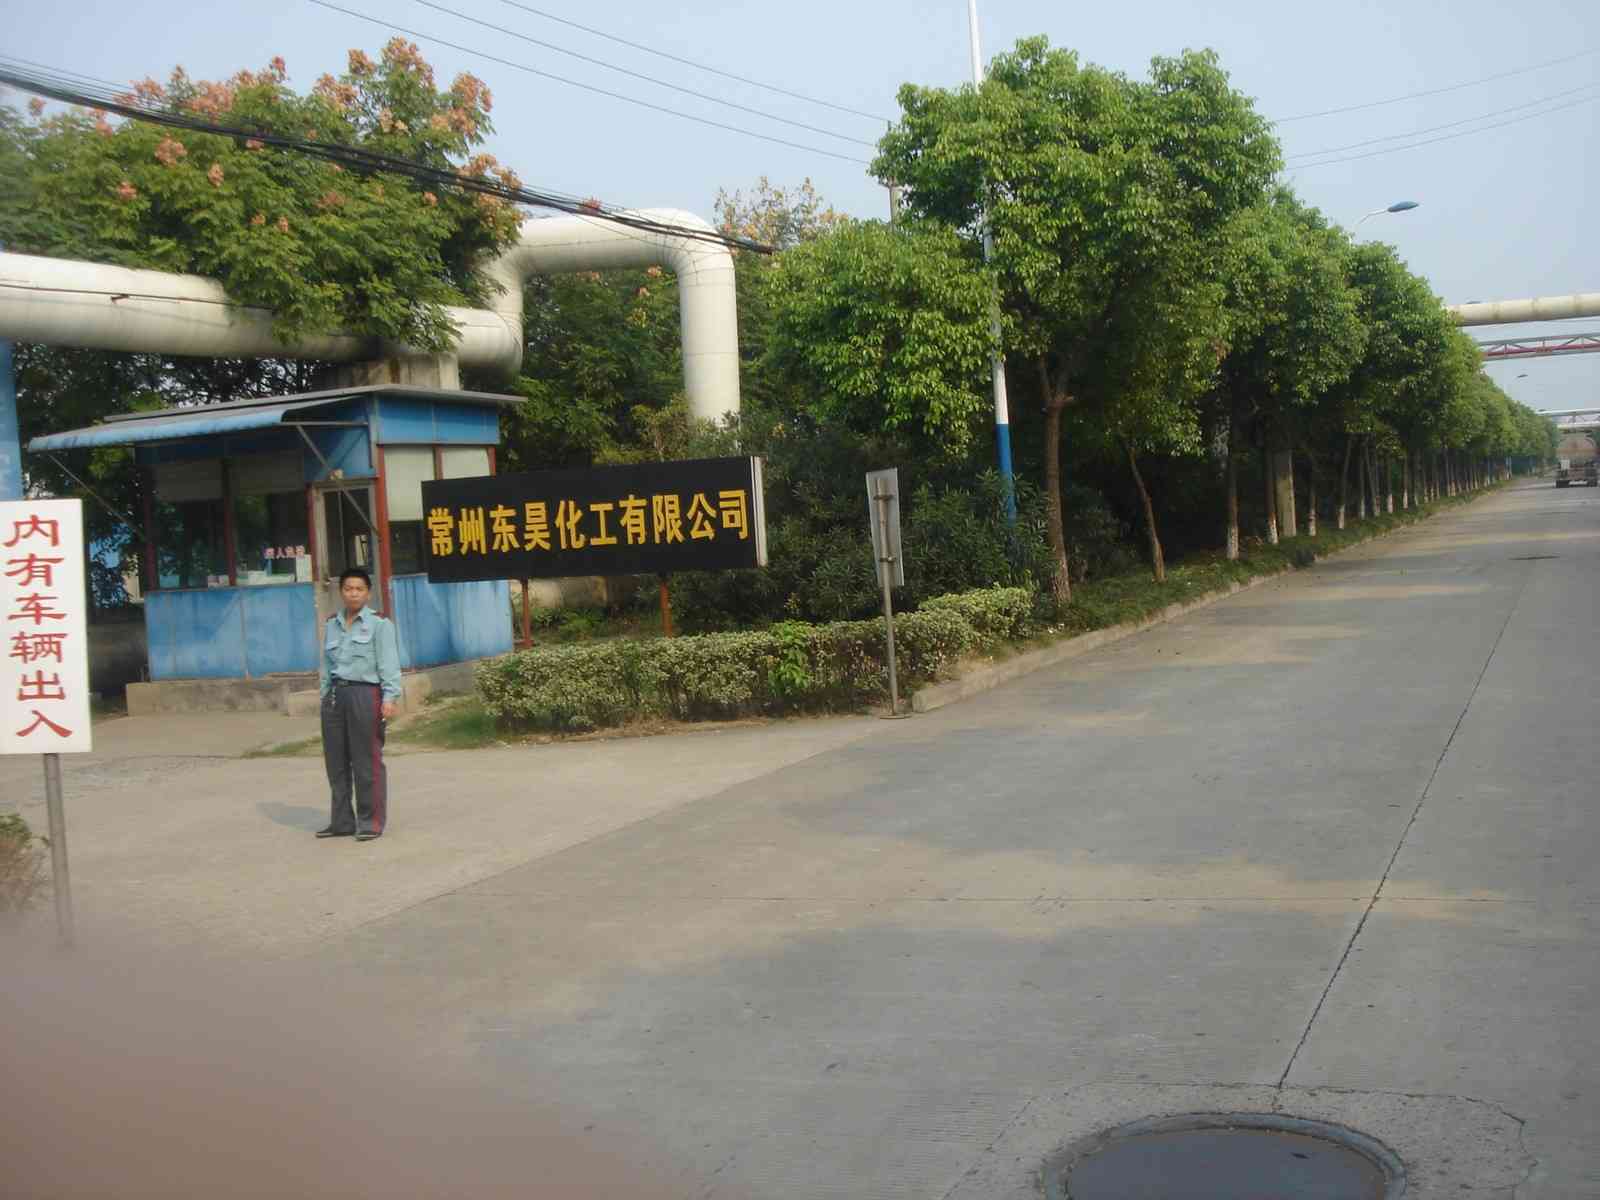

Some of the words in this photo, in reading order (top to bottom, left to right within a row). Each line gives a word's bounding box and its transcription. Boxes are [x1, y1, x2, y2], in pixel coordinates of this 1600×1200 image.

[428, 489, 749, 557] 常州东昊化工有限公司
[3, 514, 72, 738] 内有车辆出入
